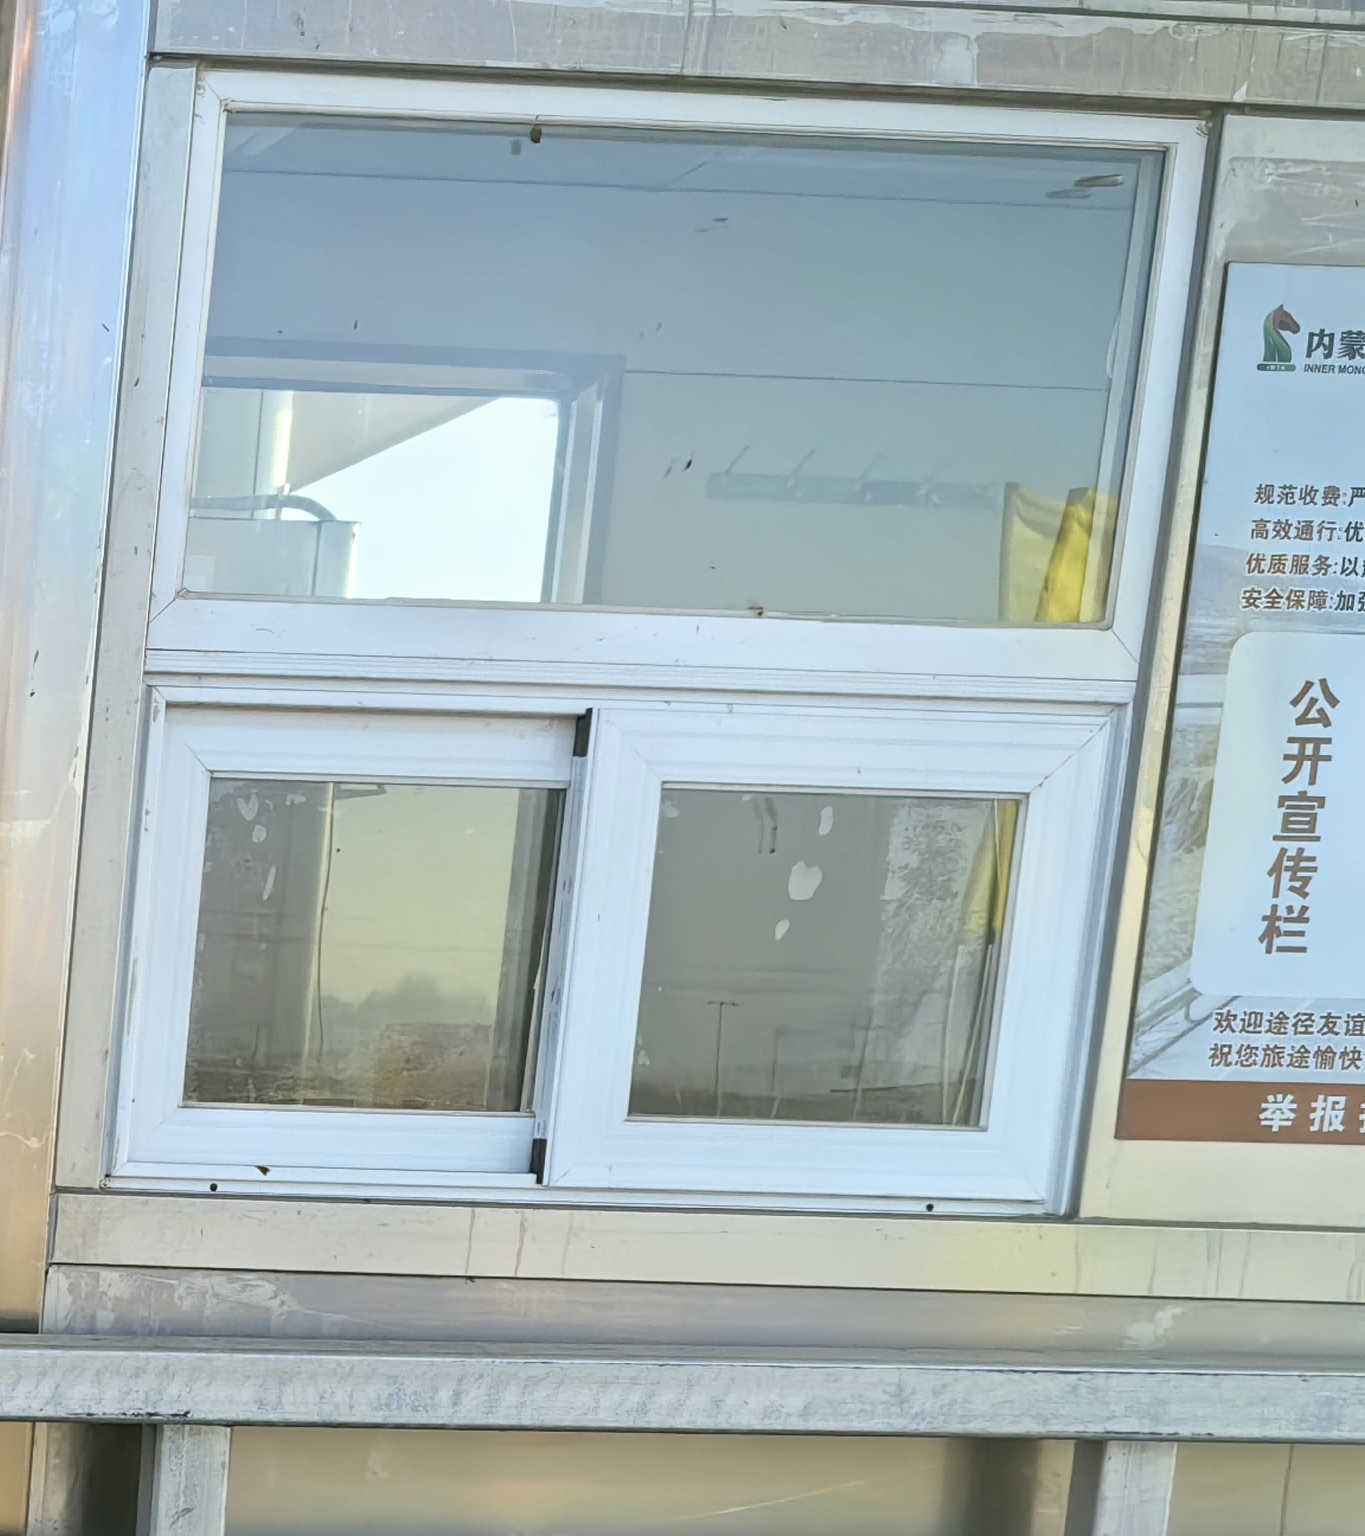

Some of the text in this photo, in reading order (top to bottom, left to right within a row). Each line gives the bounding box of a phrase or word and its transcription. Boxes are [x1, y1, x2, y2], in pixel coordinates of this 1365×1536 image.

[1306, 328, 1365, 360] 内蒙
[1304, 363, 1335, 374] INNER
[1246, 553, 1365, 577] 优质服务:以
[1258, 678, 1340, 955] 公开宣传栏
[1213, 1010, 1365, 1036] 欢迎途径友谊
[1209, 1043, 1363, 1070] 祝您旅途愉快
[1258, 1094, 1365, 1133] 举报
